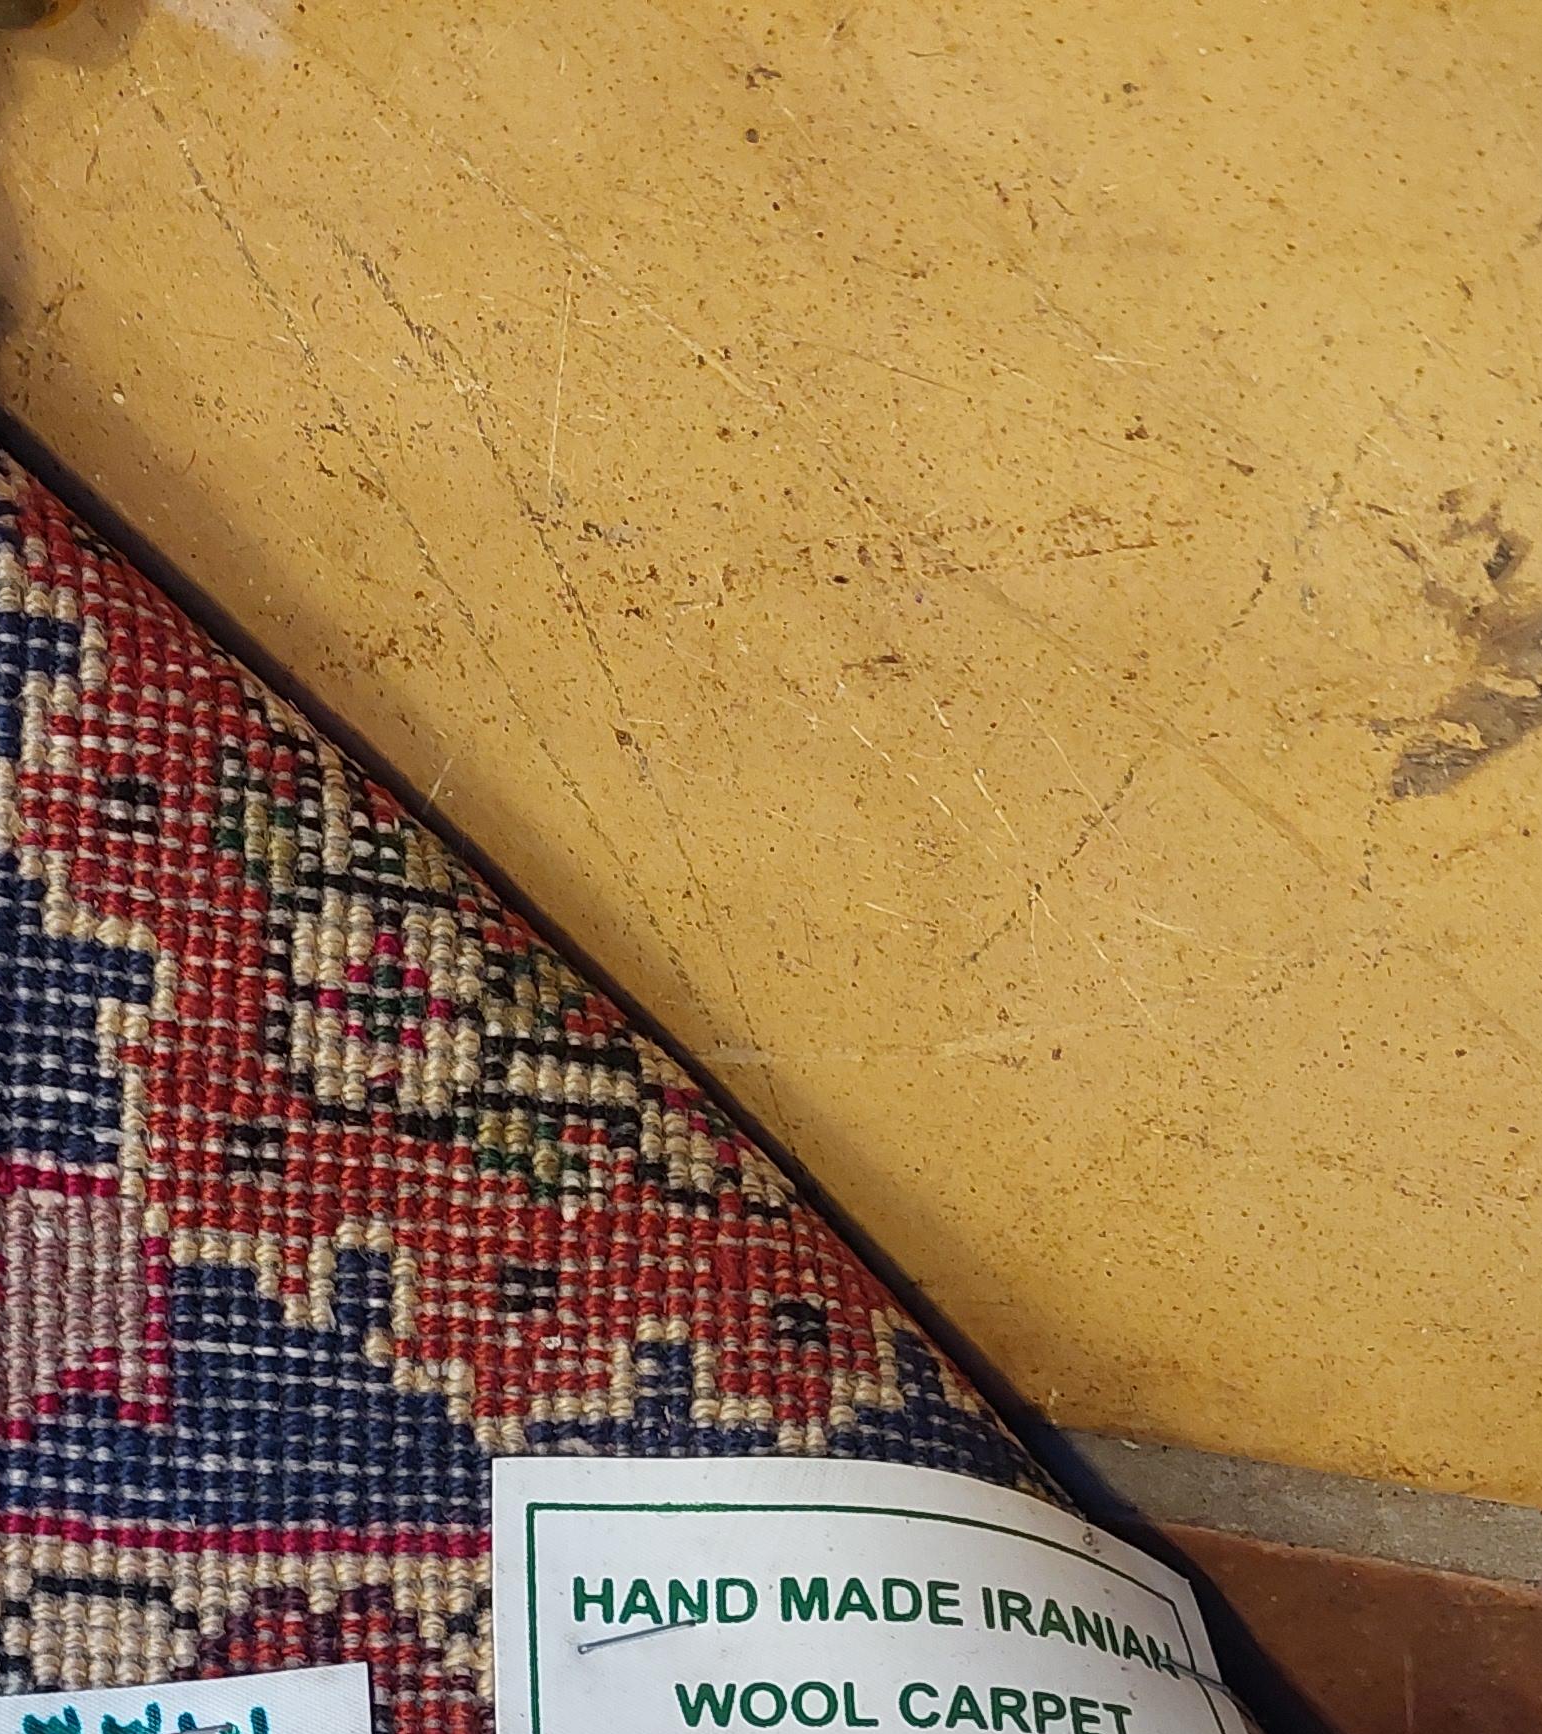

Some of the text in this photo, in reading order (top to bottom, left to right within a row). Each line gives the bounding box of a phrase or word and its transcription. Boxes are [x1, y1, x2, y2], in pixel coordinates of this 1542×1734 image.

[573, 1576, 1180, 1680] HAND MADE IRANIAN
[674, 1681, 879, 1727] WOOL
